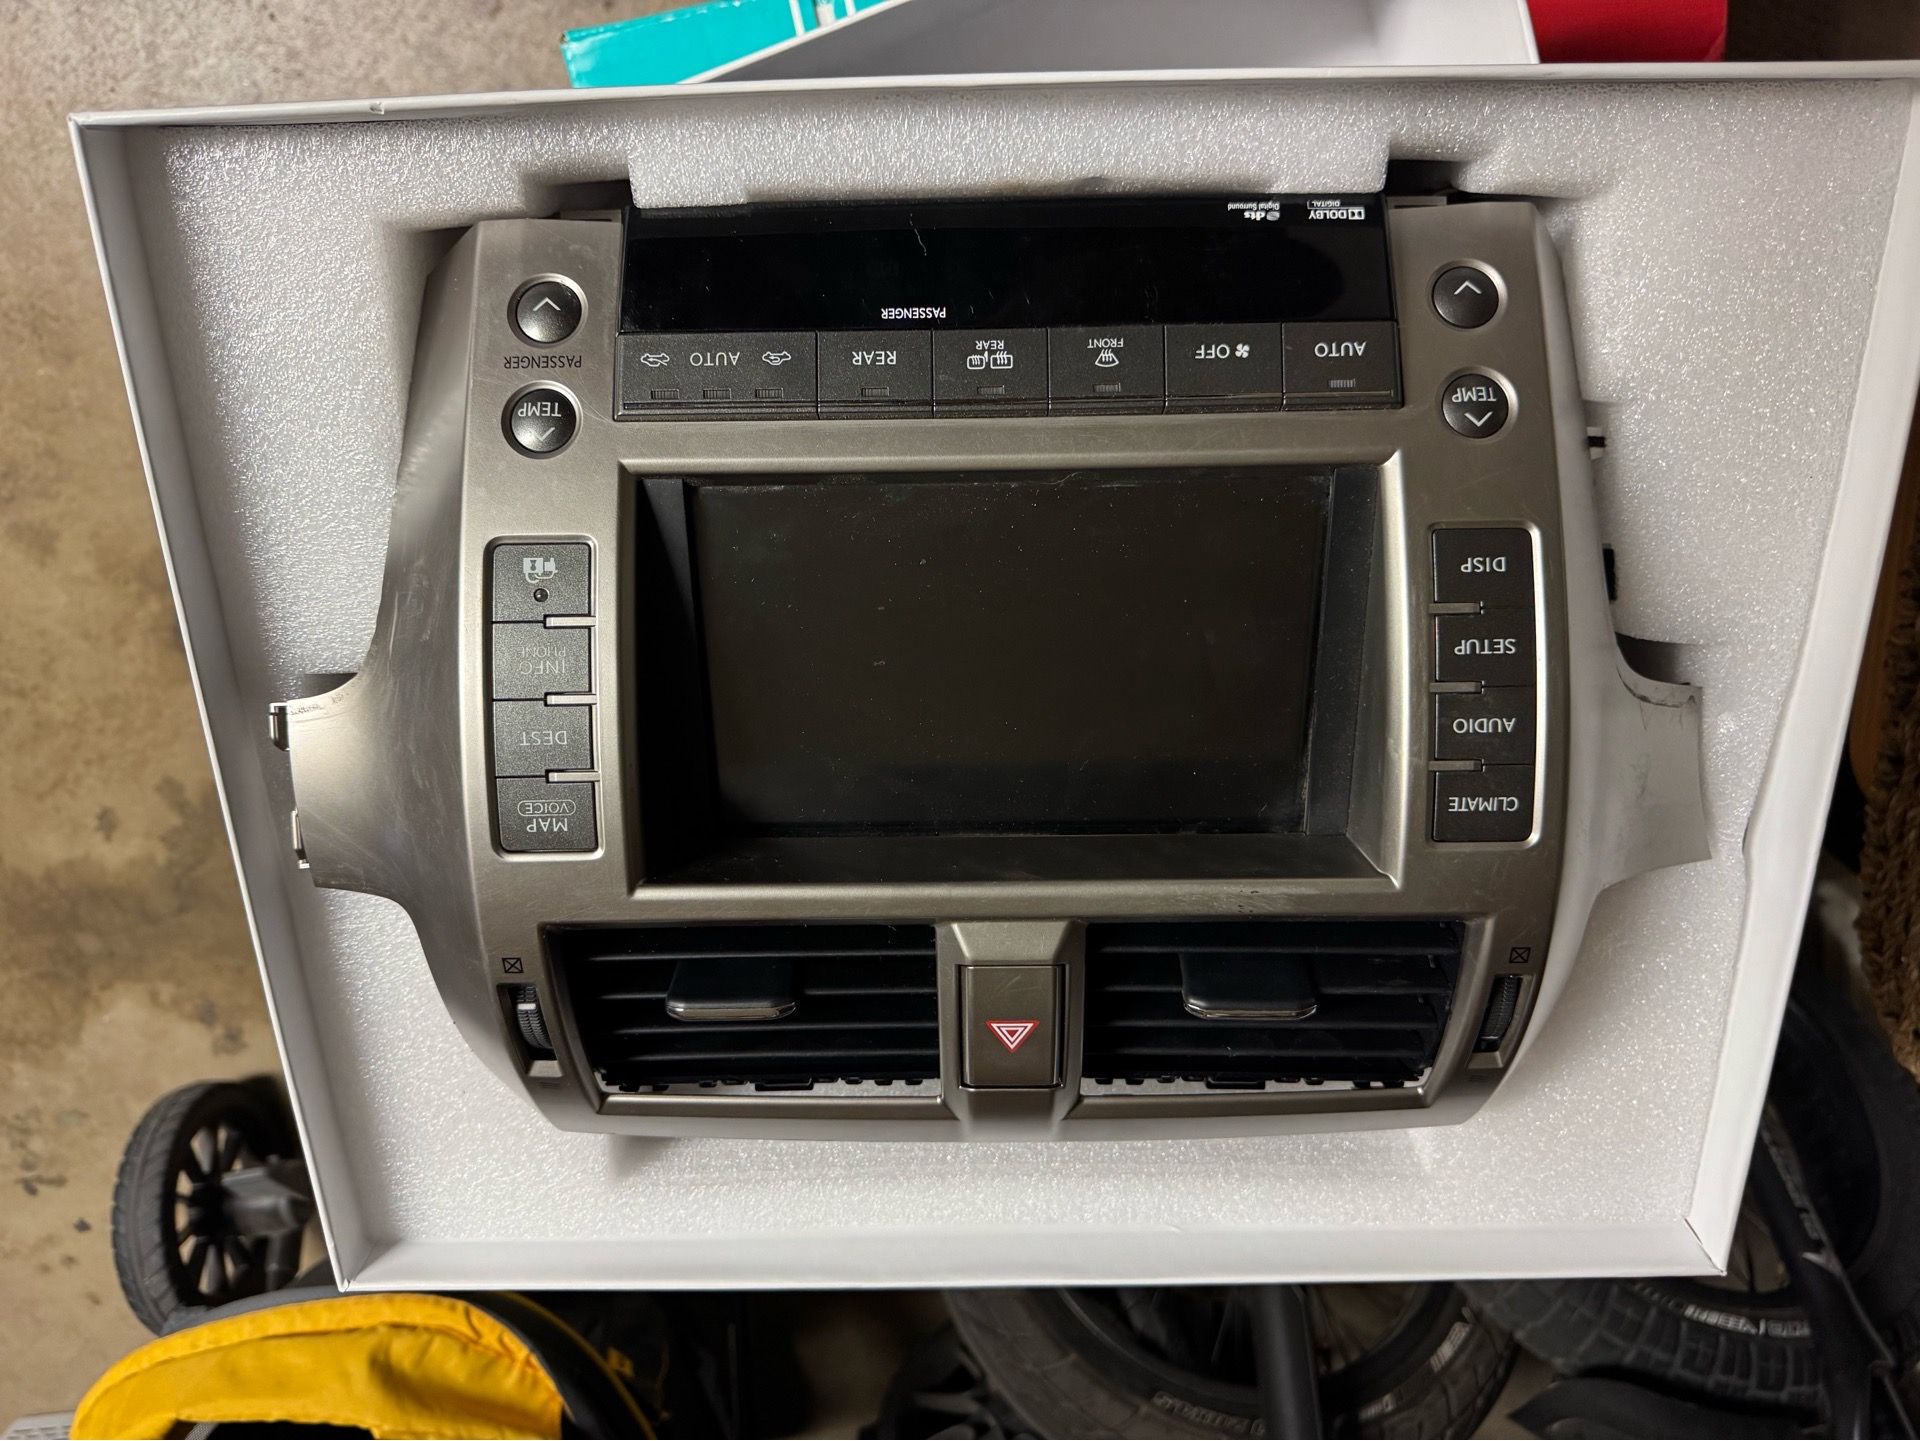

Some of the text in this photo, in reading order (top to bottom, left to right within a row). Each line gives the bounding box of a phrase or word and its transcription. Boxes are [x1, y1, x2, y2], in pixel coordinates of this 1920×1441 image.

[1244, 210, 1266, 220] dts
[1308, 210, 1347, 220] DOLBY
[881, 306, 946, 320] PASSENGER
[975, 340, 1005, 351] REAR
[1087, 337, 1124, 349] FRONT
[1314, 341, 1366, 358] AUTO
[690, 351, 740, 367] AUTO
[852, 350, 896, 366] REAR
[1195, 344, 1230, 359] OFF
[504, 355, 582, 369] PASSENGER
[1452, 386, 1496, 403] TEMP
[518, 402, 561, 418] TEMP
[1460, 556, 1506, 573] DISP
[1454, 638, 1516, 654] SETUP
[518, 659, 566, 675] INFO
[1453, 717, 1516, 733] AUDIO
[519, 730, 567, 746] DEST
[525, 802, 570, 814] VOICE
[1448, 796, 1519, 812] CLIMATE
[526, 817, 568, 833] MAP
